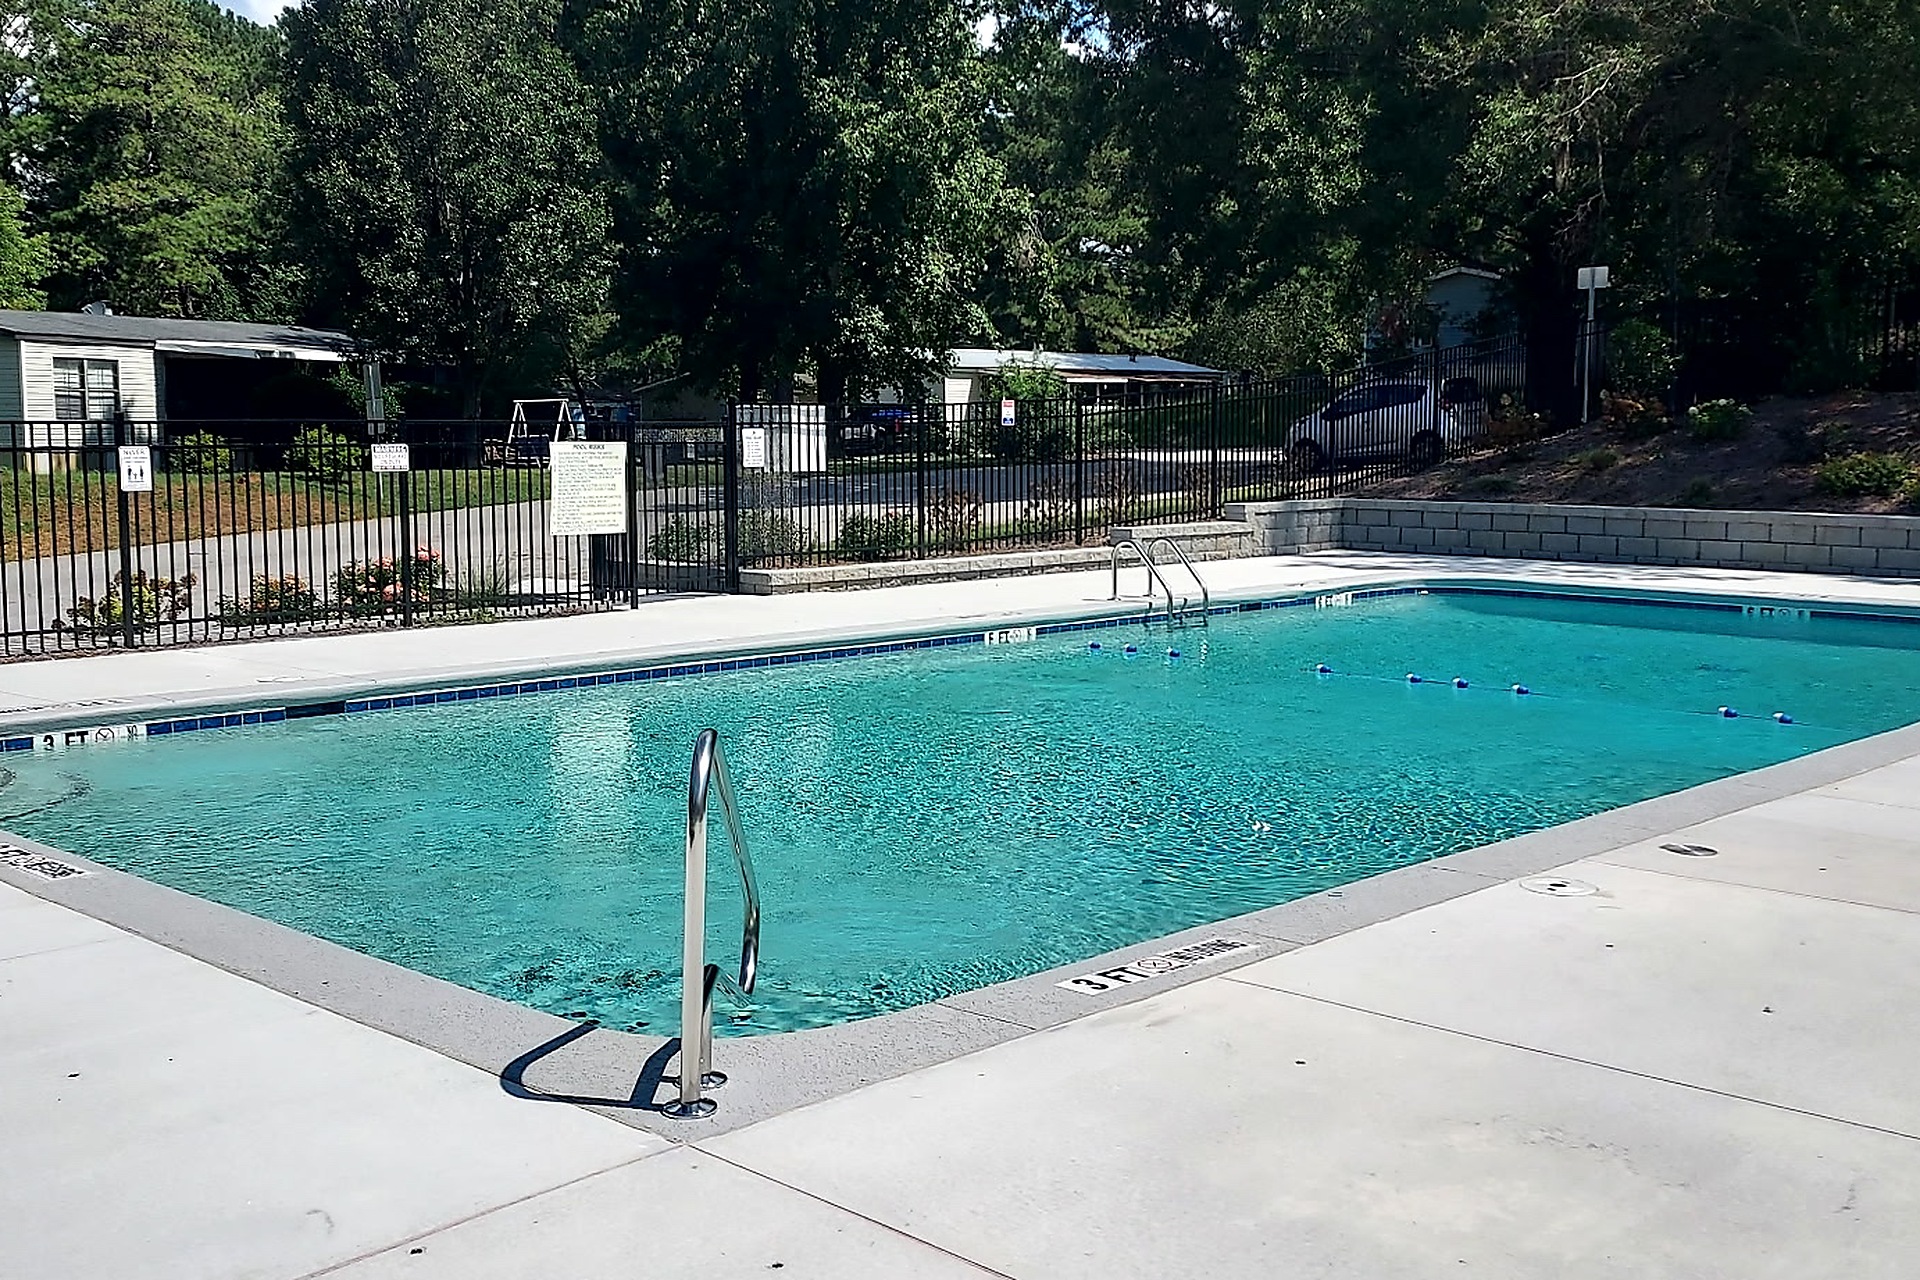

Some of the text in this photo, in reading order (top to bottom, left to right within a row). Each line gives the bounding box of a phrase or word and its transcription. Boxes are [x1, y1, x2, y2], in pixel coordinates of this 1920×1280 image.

[43, 734, 55, 751] 3
[65, 730, 89, 747] FT
[1071, 978, 1109, 990] 3
[1096, 966, 1150, 984] FT
